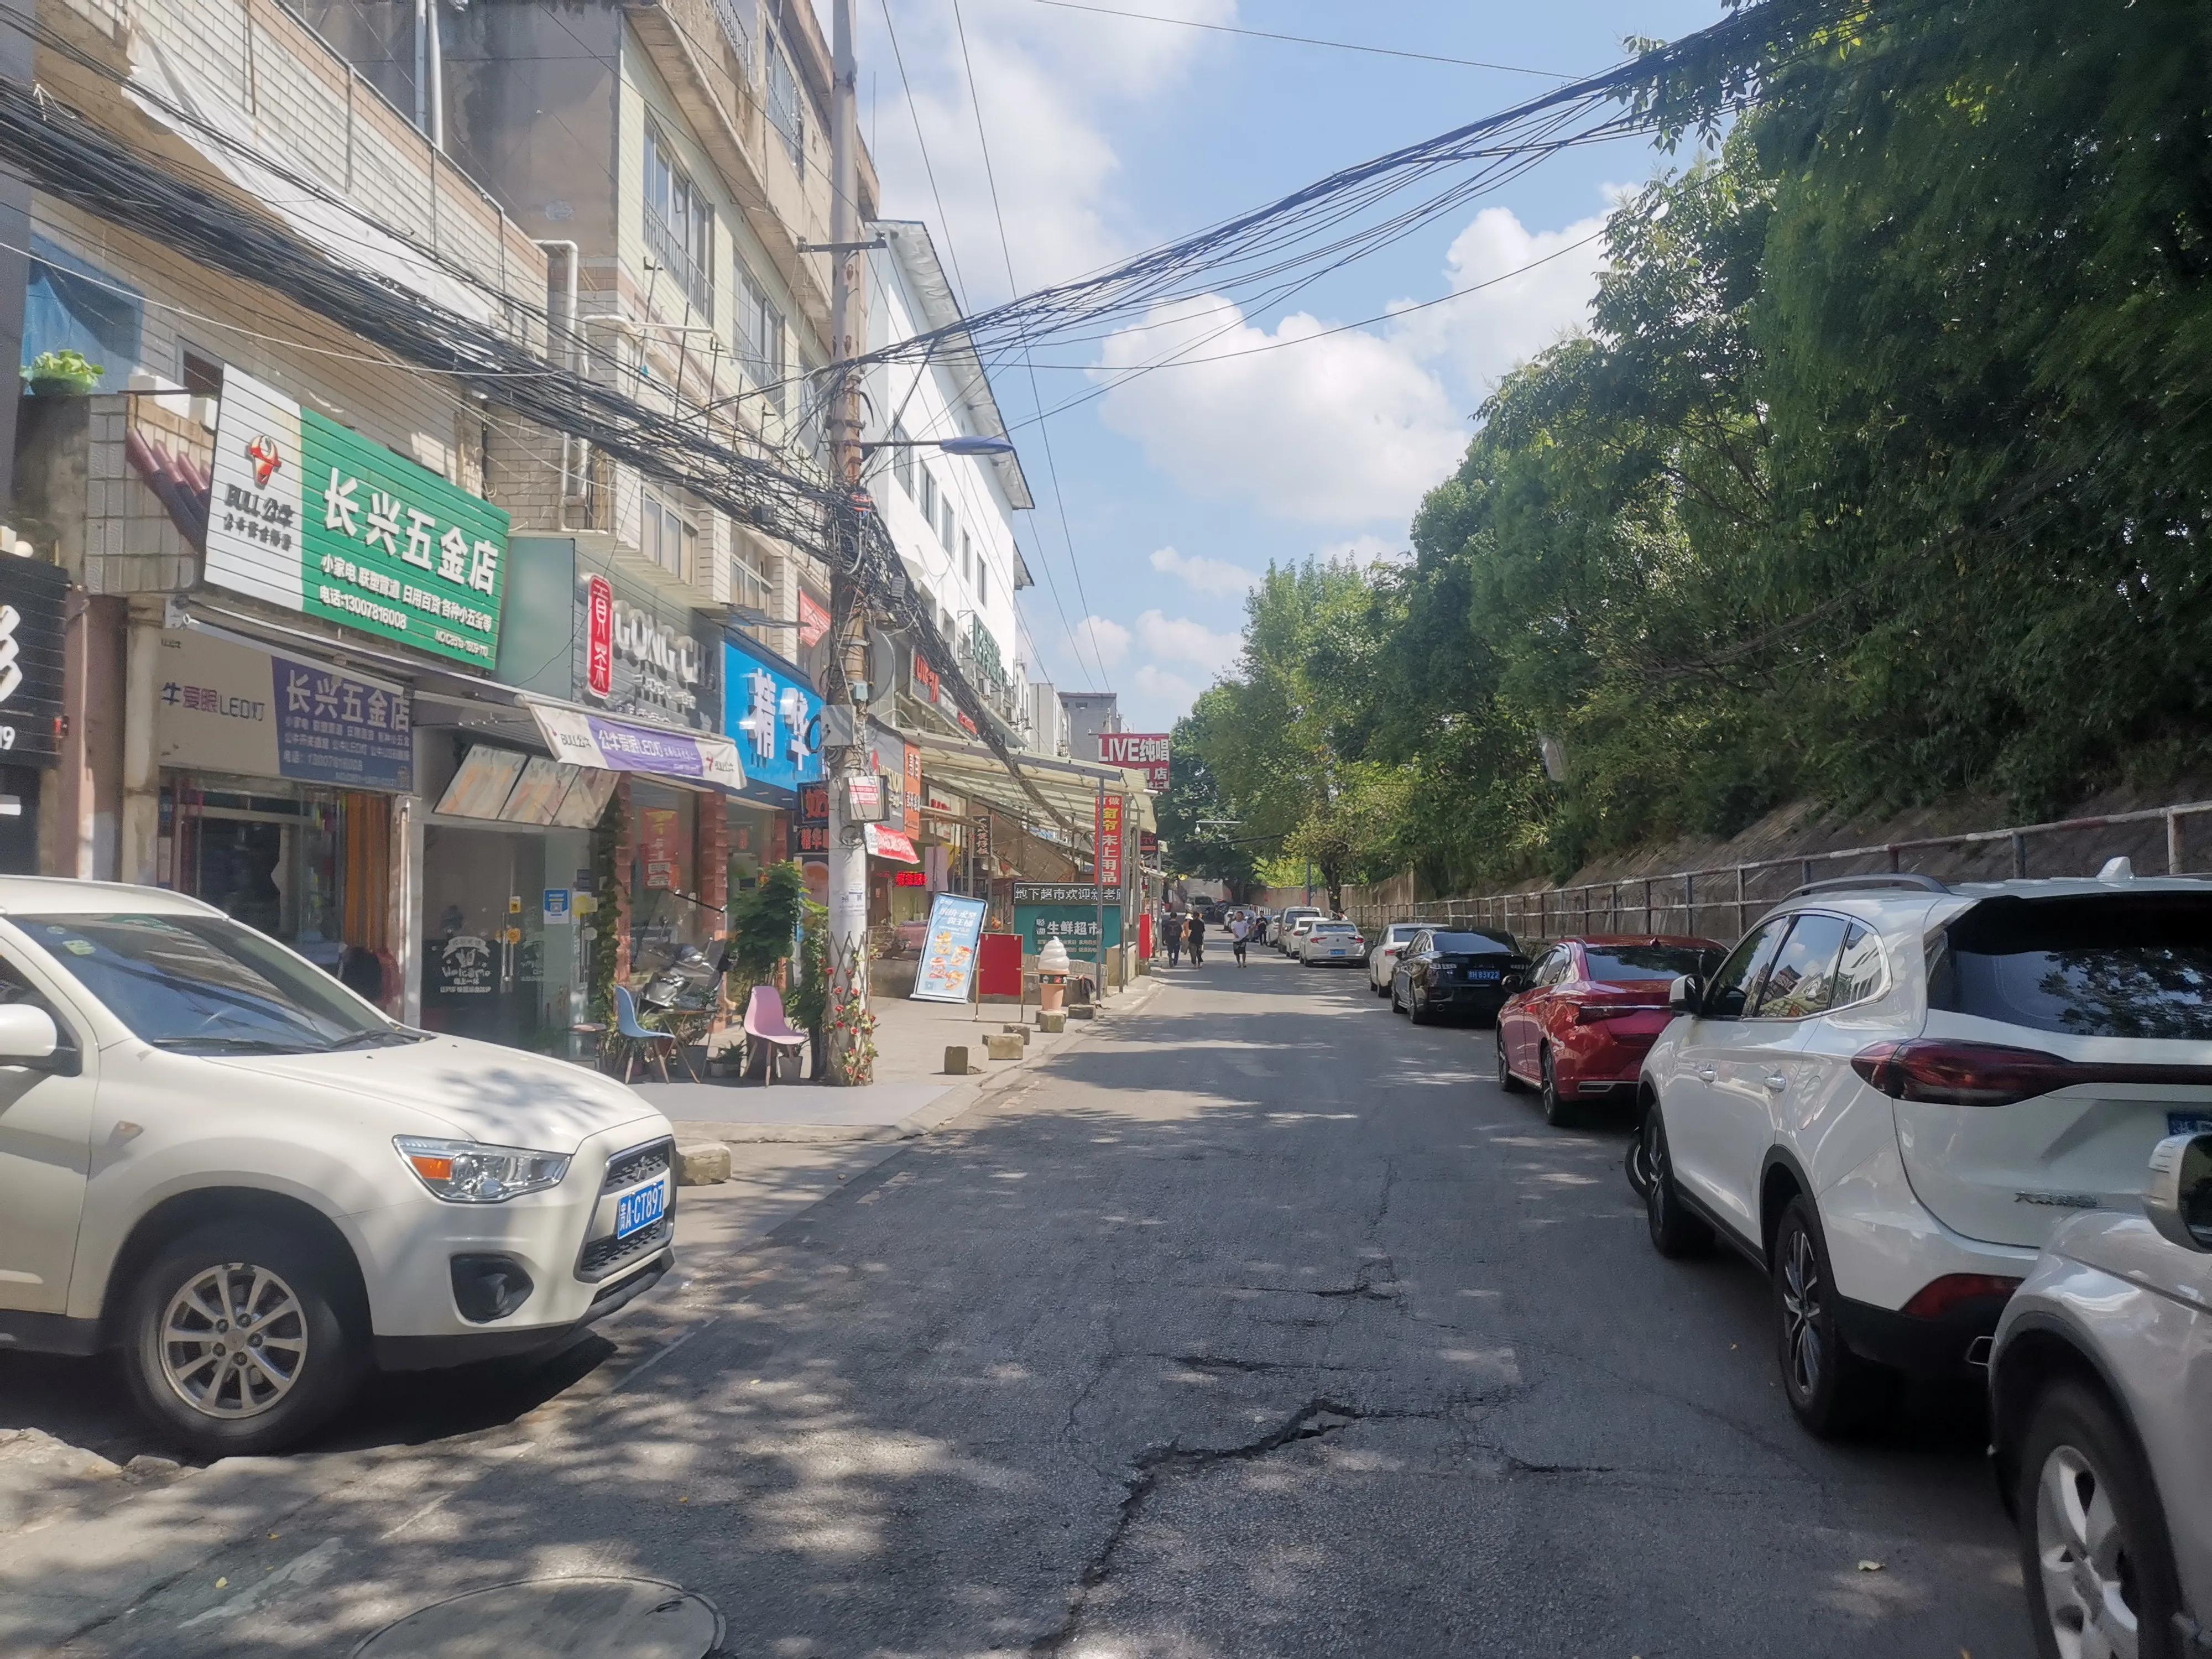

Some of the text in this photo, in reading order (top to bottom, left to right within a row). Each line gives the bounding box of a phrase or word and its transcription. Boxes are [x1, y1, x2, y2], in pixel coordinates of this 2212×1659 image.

[325, 467, 498, 596] 长兴五金店
[321, 553, 357, 582] 小家电
[403, 585, 441, 614] 日用百货
[286, 669, 410, 733] 长兴五金店
[1098, 738, 1169, 763] LIVE纯唱
[1047, 921, 1100, 935] 生鲜超市
